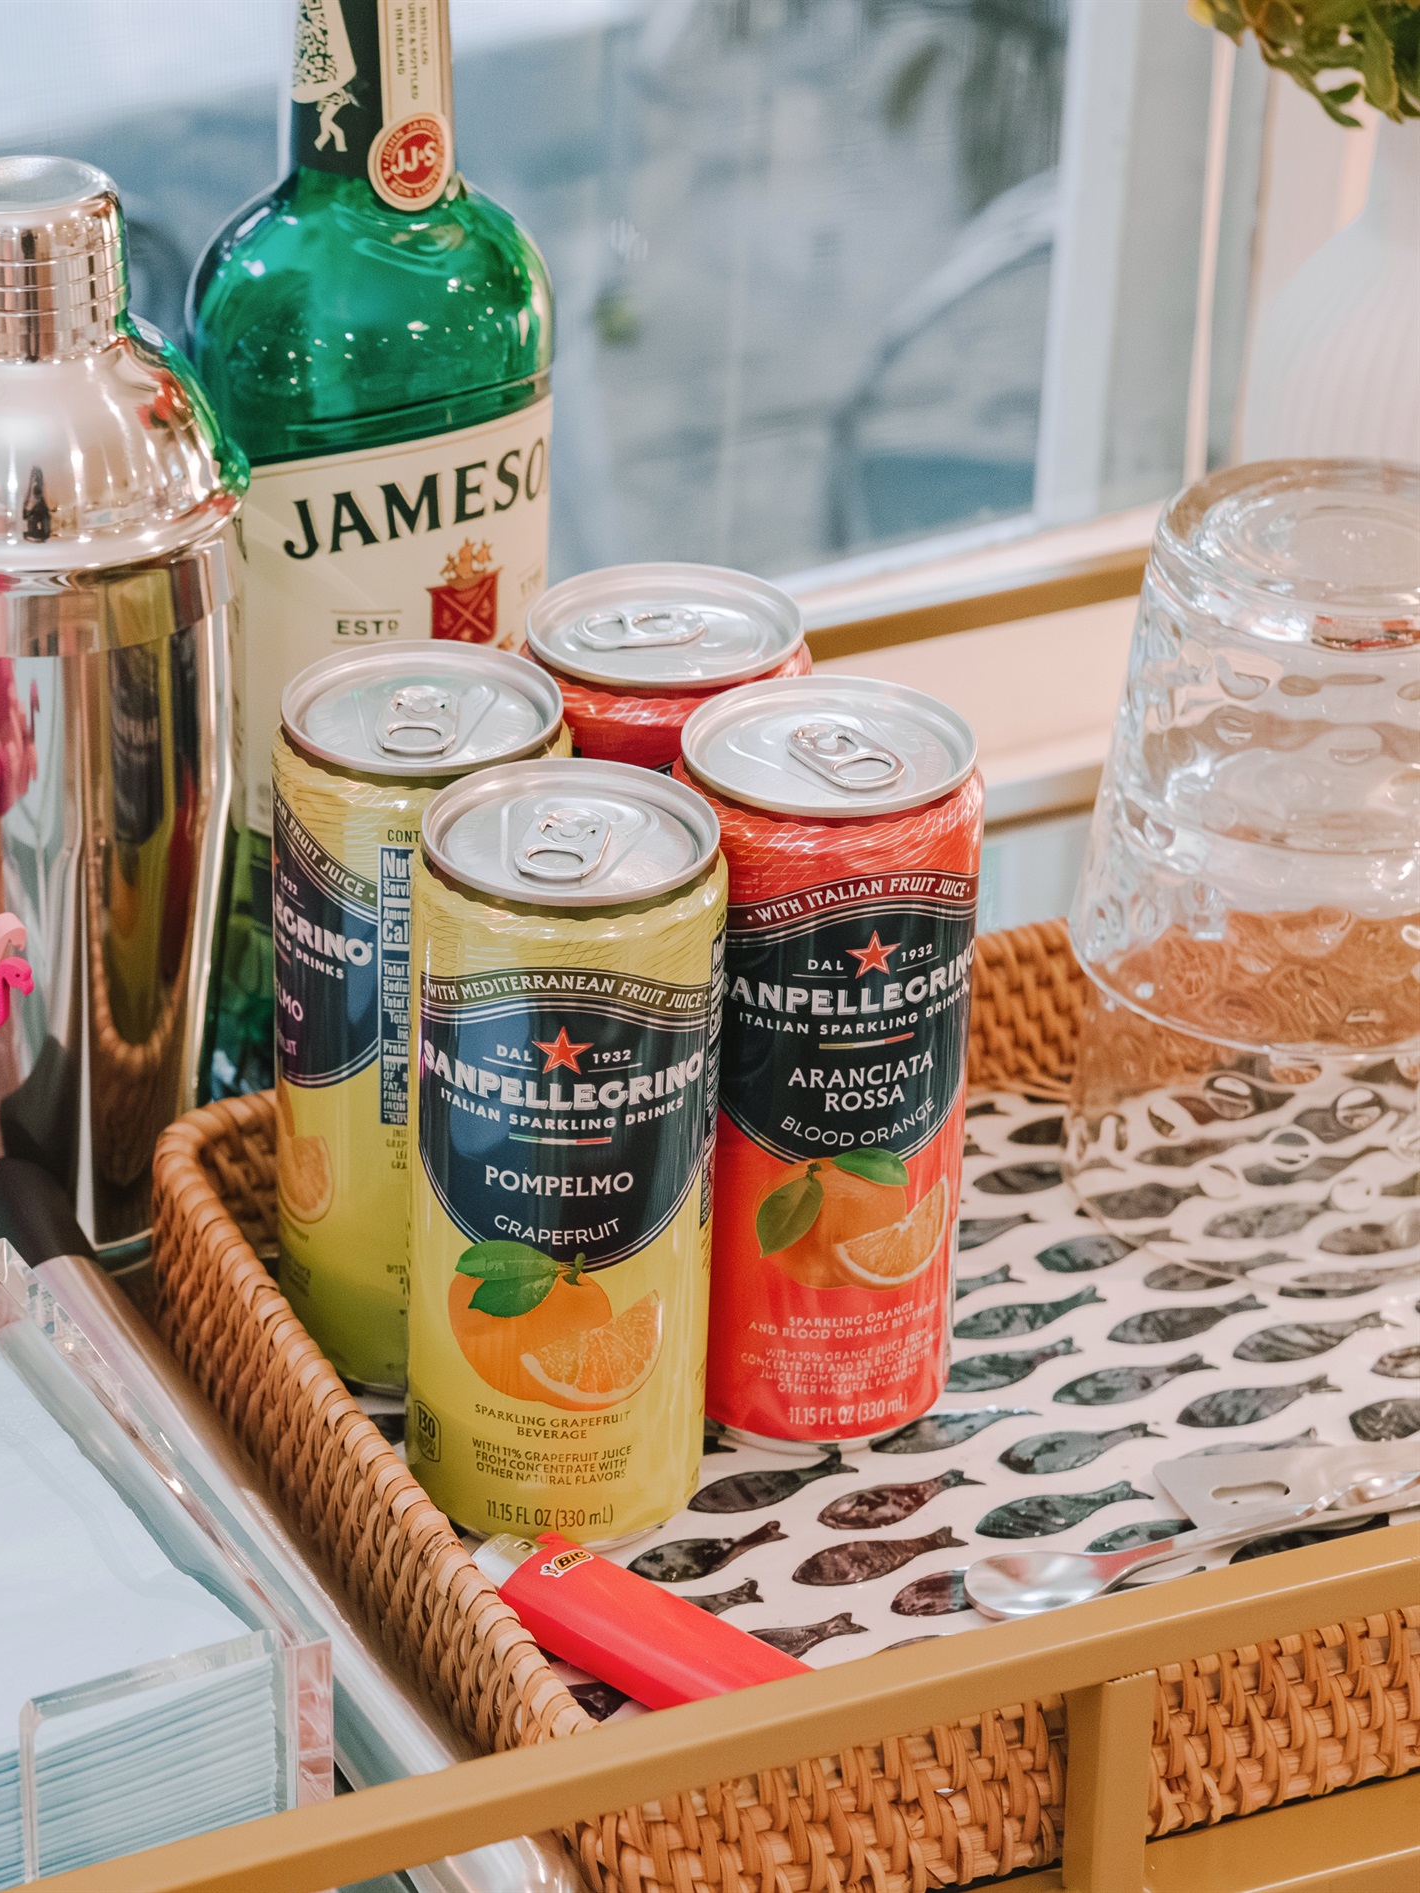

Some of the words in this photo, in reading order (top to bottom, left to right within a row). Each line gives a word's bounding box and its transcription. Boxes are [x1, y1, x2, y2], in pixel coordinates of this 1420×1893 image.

[284, 437, 547, 560] JAMESO
[288, 818, 322, 861] FRUIT
[320, 861, 366, 897] JUICE
[754, 898, 804, 923] WITH
[805, 879, 884, 909] ITALIAN
[888, 876, 935, 893] FRUIT
[934, 878, 968, 898] JUICE
[295, 946, 345, 980] DRINKS
[807, 959, 845, 971] DAL
[900, 943, 934, 964] 1932
[383, 980, 410, 993] Sodiu
[428, 981, 459, 1001] WITH
[459, 974, 616, 999] MEDITERRANEAN
[618, 982, 666, 1006] FRUIT
[665, 990, 704, 1009] JUICE
[739, 1011, 810, 1034] ITALIAN
[819, 1011, 920, 1036] SPARKLING
[495, 1043, 533, 1062] DAL
[592, 1049, 632, 1064] 1932
[422, 1039, 705, 1111] SANPELLEGRINO
[787, 1050, 935, 1090] ARANCIATA
[440, 1086, 502, 1123] ITALIAN
[509, 1113, 617, 1131] SPARKLING
[625, 1096, 685, 1126] DRINKS
[823, 1084, 906, 1113] ROSSA
[779, 1115, 855, 1147] BLOOD
[859, 1096, 936, 1146] ORANGE
[484, 1164, 635, 1197] POMPELMO
[493, 1214, 622, 1247] GRAPEFRUIT
[789, 1314, 864, 1328] SPARKLING
[865, 1300, 914, 1324] ORANGE
[748, 1321, 779, 1336] AND
[781, 1327, 831, 1339] BLOOD
[834, 1320, 889, 1339] ORANGE
[474, 1403, 547, 1428] SPARKLING
[550, 1410, 632, 1429] GRAPEFRUIT
[819, 1406, 835, 1426] FL
[837, 1406, 855, 1425] OZ
[516, 1426, 588, 1440] BEVERAGE
[471, 1437, 501, 1455] WITH
[502, 1446, 522, 1459] 11%
[524, 1450, 600, 1464] GRAPEFRUIT
[600, 1445, 633, 1460] JUICE
[475, 1450, 507, 1467] FROM
[509, 1458, 597, 1474] CONCENTRATE
[598, 1457, 628, 1471] WITH
[475, 1462, 514, 1481] OTHER
[515, 1472, 572, 1486] NATURAL
[574, 1469, 627, 1485] FLAVORS
[486, 1500, 514, 1523] 11.15
[515, 1506, 531, 1525] FL
[534, 1509, 552, 1527] OZ
[555, 1509, 586, 1531] (330
[588, 1503, 614, 1526] mL)
[558, 1551, 589, 1569] BIC
